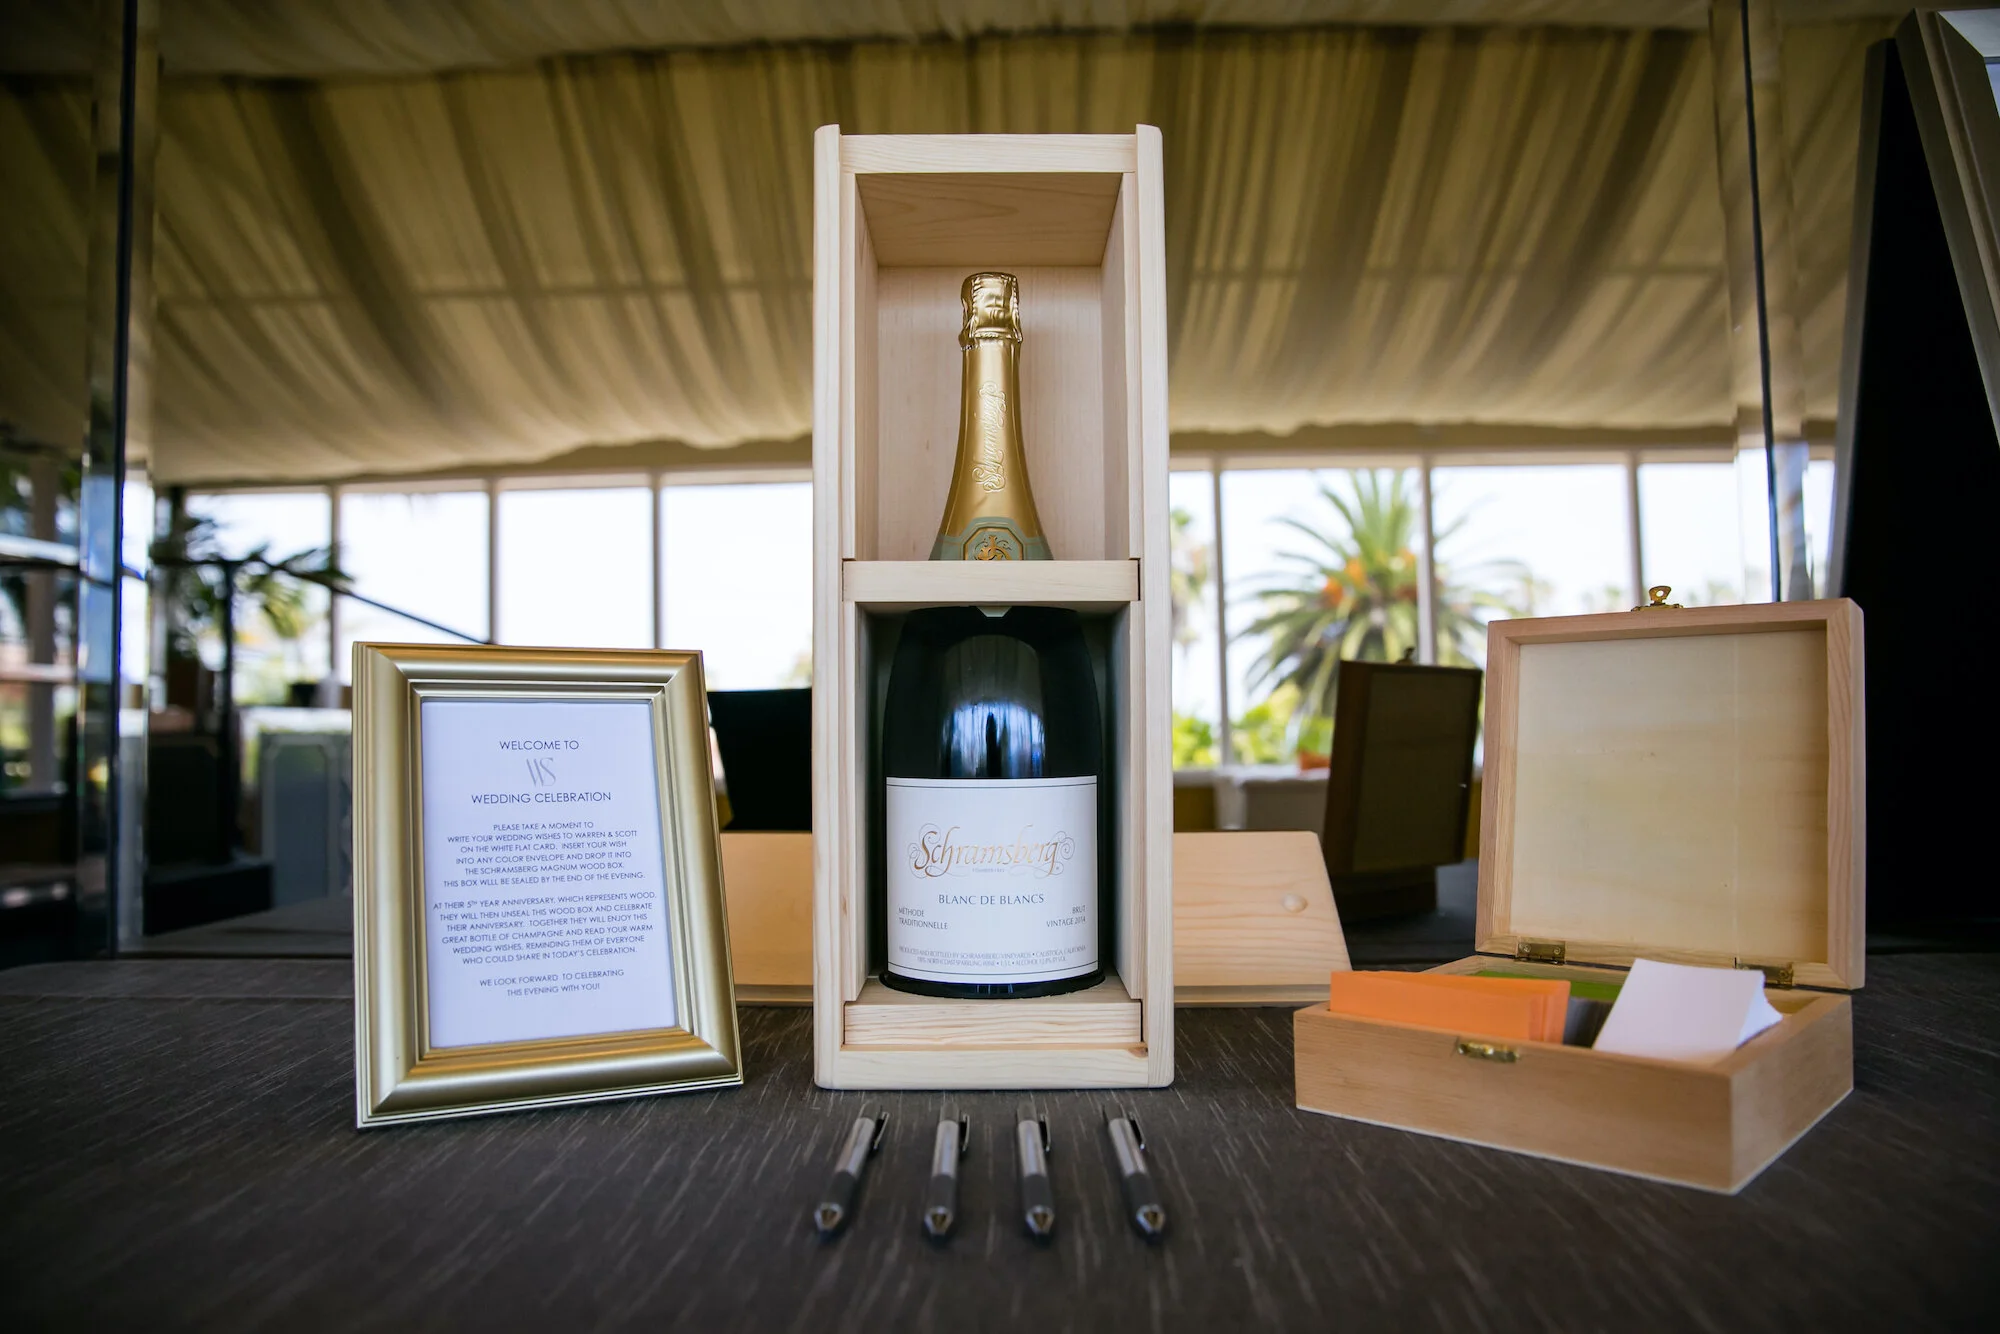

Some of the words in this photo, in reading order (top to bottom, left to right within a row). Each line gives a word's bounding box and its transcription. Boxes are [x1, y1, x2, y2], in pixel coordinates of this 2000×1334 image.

[499, 741, 560, 749] WELCOME
[564, 741, 579, 749] TO
[471, 793, 530, 804] WEDDING
[534, 791, 611, 802] CELEBRATION
[493, 823, 520, 831] PLEASE
[521, 822, 539, 830] TAKE
[540, 822, 546, 830] A
[548, 821, 582, 830] MOMENT
[447, 836, 470, 844] WRITE
[471, 835, 493, 843] YOUR
[494, 833, 533, 842] WEDDING
[534, 832, 561, 841] WISHES
[562, 832, 573, 840] TO
[574, 831, 606, 839] WARREN
[614, 830, 636, 838] SCOTT
[475, 845, 489, 853] THE
[490, 844, 513, 852] WHITE
[514, 843, 530, 851] FLAT
[561, 841, 584, 850] INSERT
[584, 841, 607, 849] YOUR
[608, 840, 626, 848] WISH
[908, 823, 1068, 878] Schramsberg
[456, 857, 474, 865] INTO
[476, 856, 493, 864] ANY
[494, 855, 524, 863] COLOR
[525, 853, 564, 862] ENVELOPE
[566, 852, 583, 860] AND
[584, 851, 606, 860] DROP
[607, 851, 612, 859] IT
[614, 850, 632, 858] INTO
[465, 867, 478, 875] THE
[480, 865, 538, 875] SCHRAMSBERG
[540, 863, 578, 872] MAGNUM
[578, 862, 606, 871] WOOD
[443, 880, 458, 888] THIS
[460, 879, 478, 887] BOX
[500, 877, 510, 885] BE
[510, 876, 539, 885] SEALED
[552, 875, 565, 883] THE
[566, 874, 582, 882] END
[596, 873, 609, 881] THE
[433, 902, 442, 910] AT
[444, 901, 464, 910] THEIR
[479, 899, 500, 908] YEAR
[557, 895, 584, 904] WHICH
[585, 893, 628, 902] REPRESENTS
[938, 894, 977, 905] BLANC
[980, 894, 996, 905] DE
[999, 893, 1045, 905] BLANCS
[440, 913, 458, 921] THEY
[460, 912, 478, 920] WILL
[479, 911, 499, 919] THEN
[500, 909, 530, 918] UNSEAL
[532, 908, 547, 916] THIS
[548, 906, 576, 915] WOOD
[576, 906, 593, 914] BOX
[594, 904, 612, 913] AND
[613, 902, 652, 912] CELEBRATE
[446, 924, 467, 932] THEIR
[529, 918, 568, 927] TOGETHER
[570, 917, 587, 925] THEY
[588, 916, 606, 924] WILL
[606, 914, 631, 923] ENJOY
[633, 913, 647, 922] THIS
[898, 917, 948, 930] TRADITIONNELLE
[1046, 917, 1073, 927] VINTAGE
[442, 935, 467, 944] GREAT
[469, 933, 496, 942] BOTTLE
[498, 933, 509, 941] OF
[511, 929, 564, 940] CHAMPAGNE
[565, 928, 583, 936] AND
[584, 926, 605, 935] READ
[606, 925, 628, 934] YOUR
[628, 923, 653, 932] WARM
[452, 944, 492, 954] WEDDING
[525, 939, 570, 950] REMINDING
[572, 938, 592, 947] THEM
[593, 937, 604, 945] OF
[605, 935, 644, 945] EVERYONE
[462, 956, 483, 965] WHO
[484, 954, 514, 964] COULD
[515, 952, 540, 962] SHARE
[542, 952, 550, 960] IN
[480, 979, 492, 987] WE
[493, 977, 516, 986] LOOK
[518, 974, 558, 984] FORWARD
[562, 973, 573, 981] TO
[574, 969, 624, 980] CELEBRATING
[507, 988, 522, 997] THIS
[523, 986, 558, 996] EVENING
[560, 984, 579, 993] WITH
